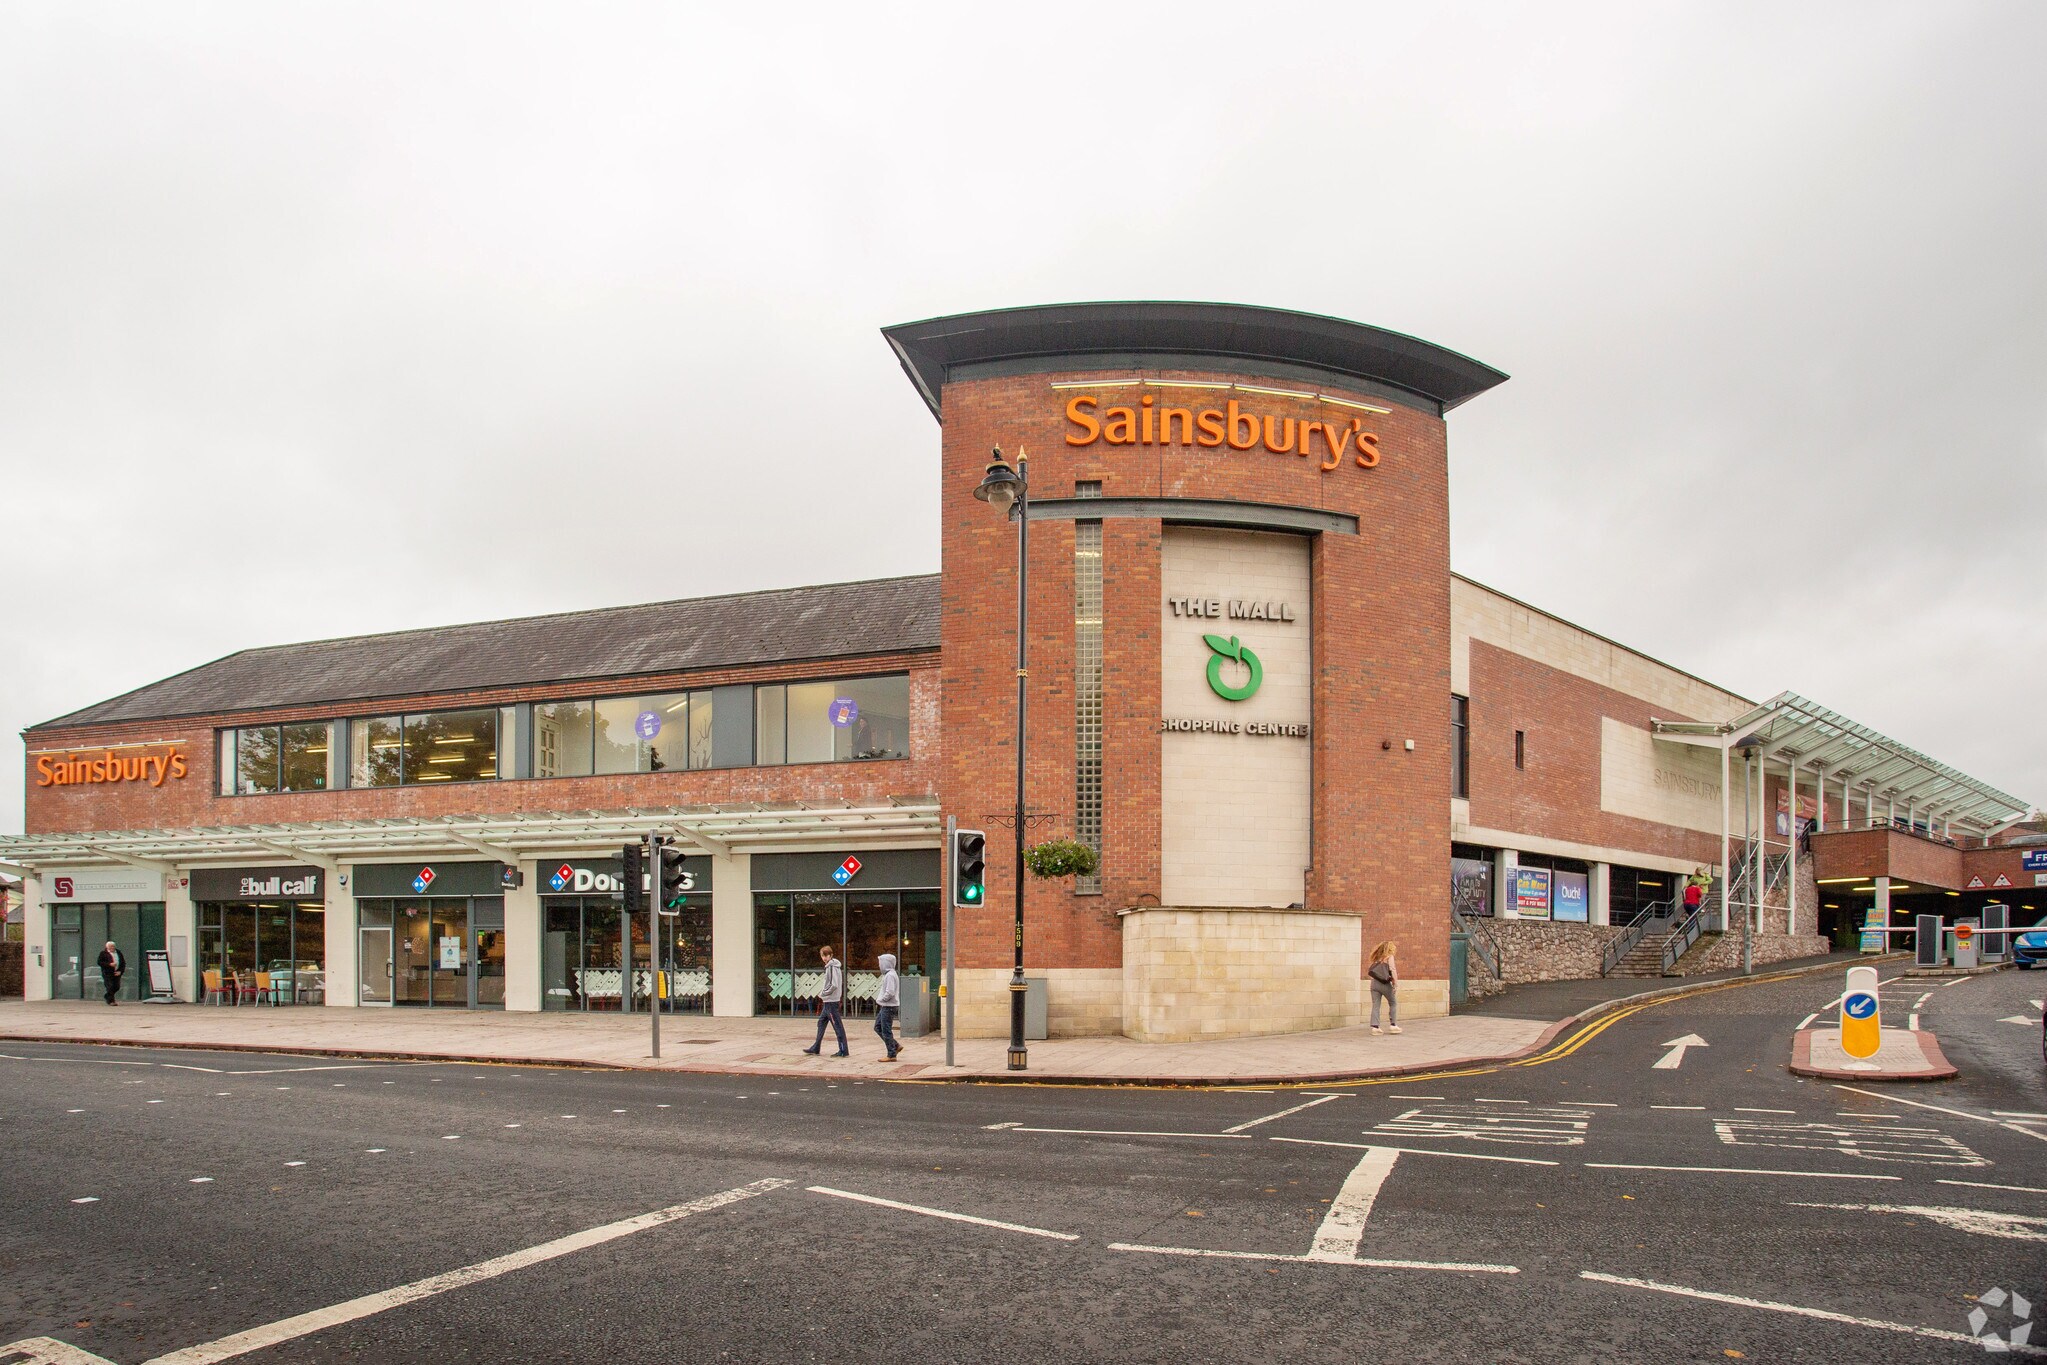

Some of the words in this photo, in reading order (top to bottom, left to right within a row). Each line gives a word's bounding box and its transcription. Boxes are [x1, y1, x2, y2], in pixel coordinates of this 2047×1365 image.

[1065, 395, 1381, 472] Sainsbury's
[1170, 598, 1220, 618] THE
[1229, 600, 1295, 622] MALL
[1161, 719, 1241, 734] SHOPPING
[1245, 722, 1309, 737] CENTRE
[36, 747, 187, 787] Sainsbury's
[1654, 768, 1721, 800] SAINSBURY'
[240, 877, 249, 896] the
[248, 877, 280, 896] bull
[281, 875, 317, 895] calf
[1561, 885, 1581, 899] Ouch!
